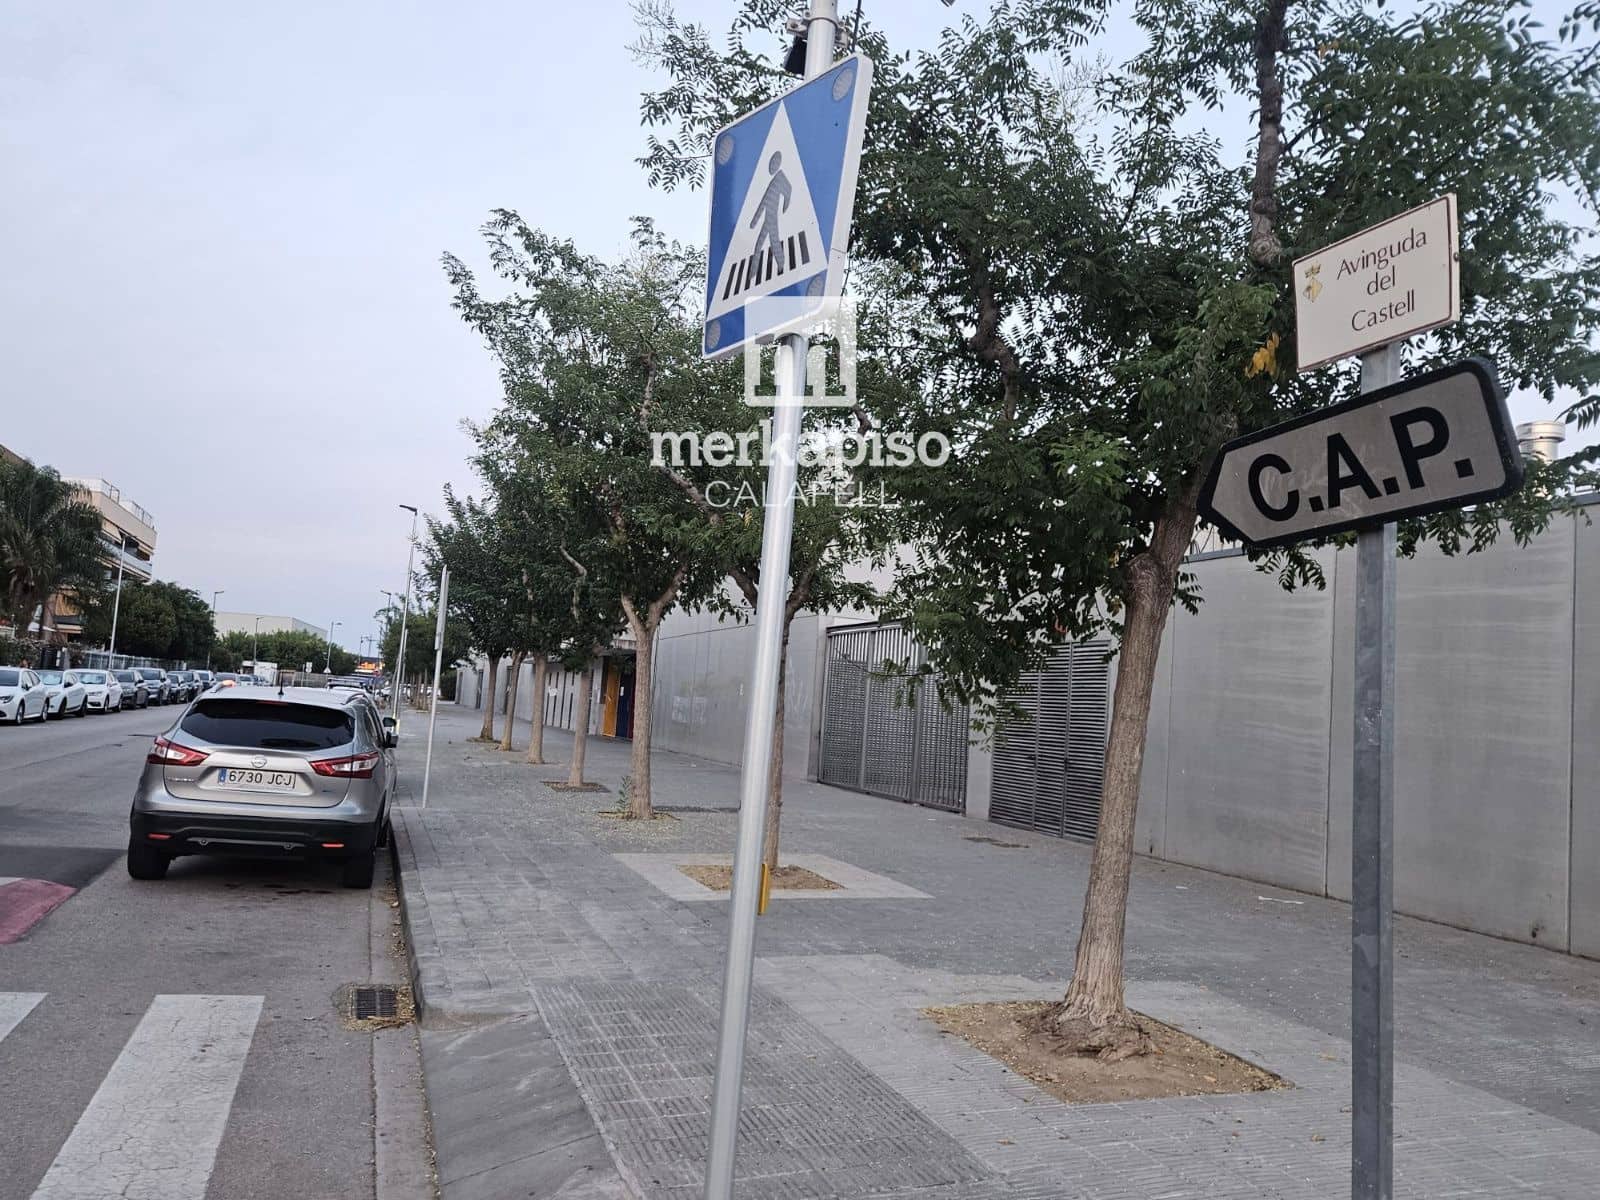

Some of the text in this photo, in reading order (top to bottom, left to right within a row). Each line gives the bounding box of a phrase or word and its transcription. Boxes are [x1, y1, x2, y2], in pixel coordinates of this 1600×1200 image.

[1336, 228, 1427, 280] Avinguda
[1366, 266, 1396, 296] del
[1351, 290, 1415, 331] Castell
[1248, 406, 1474, 522] C.A.P.
[229, 770, 292, 786] 6730 JCJ
